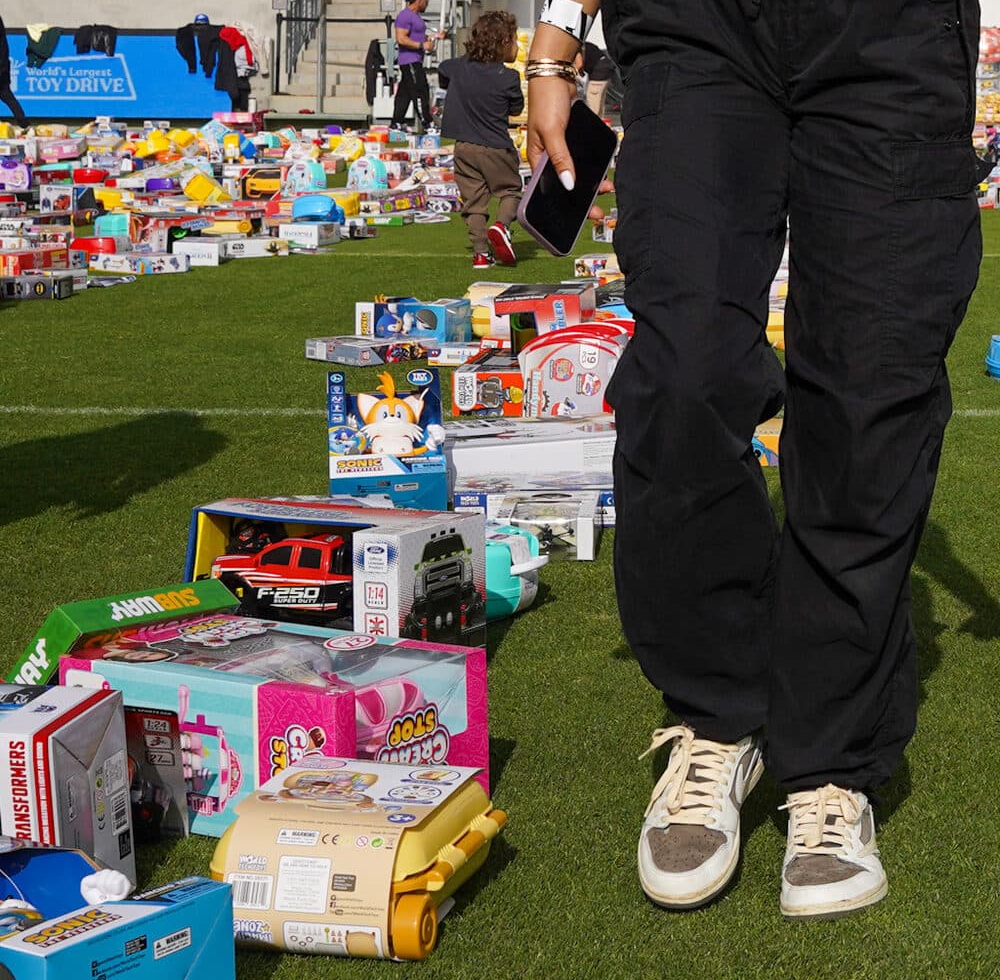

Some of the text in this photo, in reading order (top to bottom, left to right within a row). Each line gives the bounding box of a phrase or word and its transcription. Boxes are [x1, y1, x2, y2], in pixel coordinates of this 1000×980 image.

[26, 67, 112, 79] World's Largest
[26, 77, 126, 93] TOY DRIVE
[336, 458, 383, 469] SONIC
[257, 587, 321, 599] F-250
[367, 586, 385, 600] 1:14
[110, 587, 201, 622] SUBWAY
[389, 707, 437, 746] STOP
[9, 741, 33, 841] RANSFORMERS
[22, 908, 110, 945] SONIC
